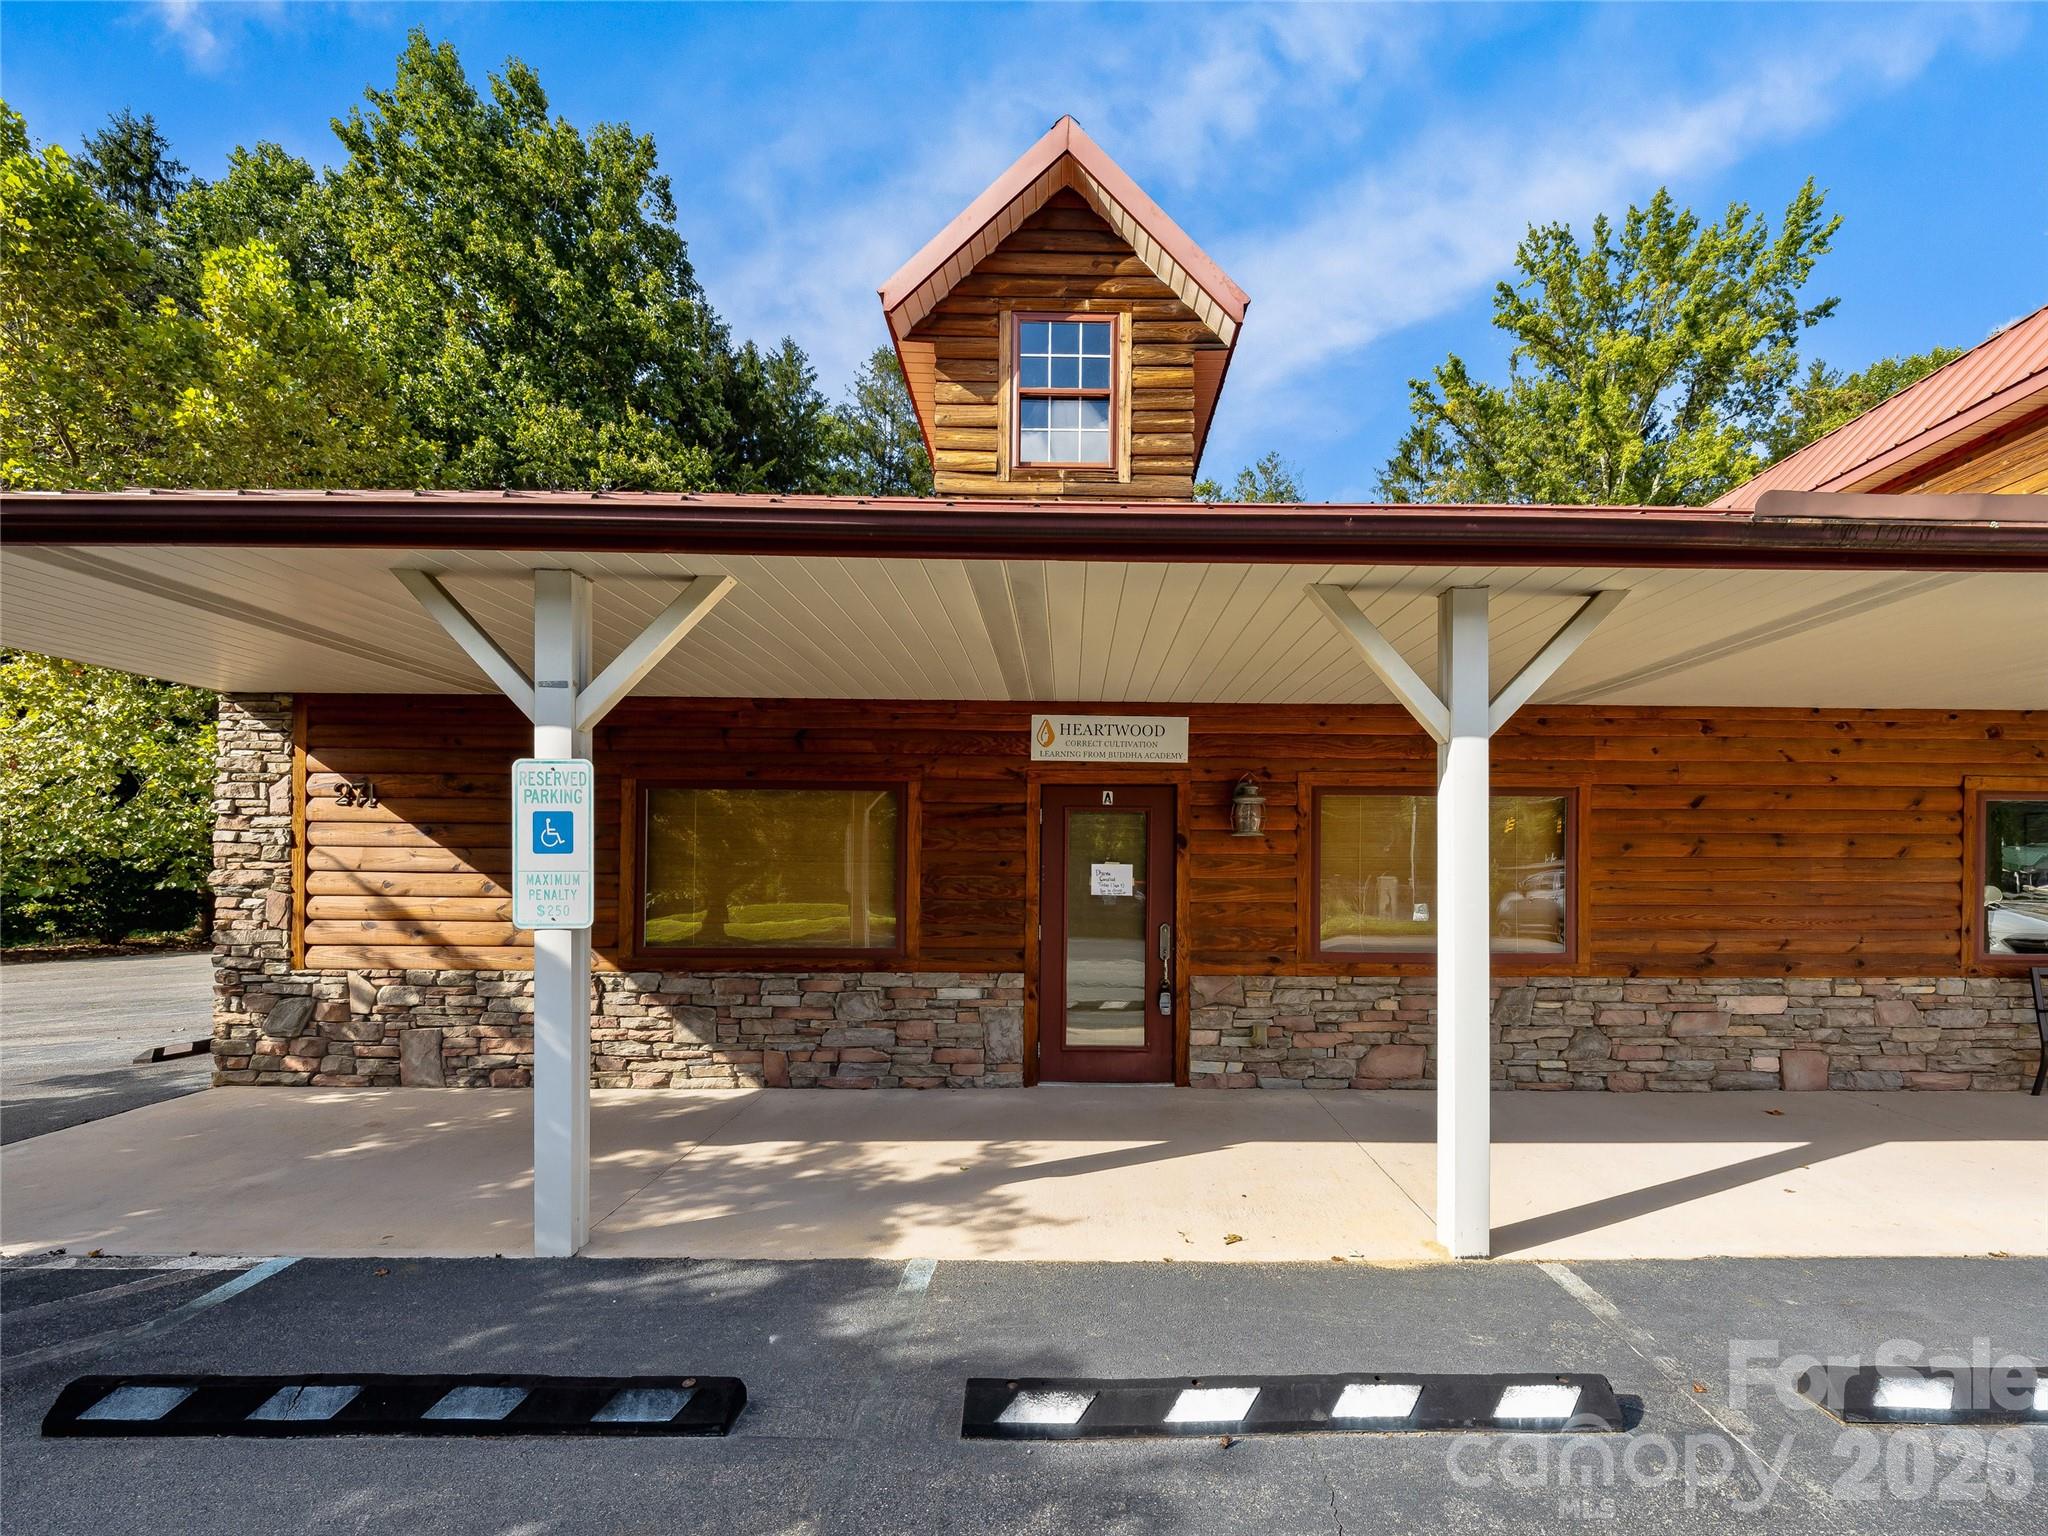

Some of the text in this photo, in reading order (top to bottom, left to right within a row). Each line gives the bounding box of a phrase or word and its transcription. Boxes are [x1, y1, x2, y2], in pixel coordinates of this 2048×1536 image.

[1060, 723, 1165, 737] HEARTWOOD
[1065, 740, 1158, 749] CORRECT CULTIVATION
[1040, 750, 1184, 760] LEARNING FROM BUDDHA ACADEMY
[519, 771, 587, 786] RESERVED
[524, 789, 583, 804] PARKING
[1104, 791, 1112, 804] A
[526, 873, 580, 886] MAXIMUM
[528, 889, 577, 901] PENALTY
[537, 904, 570, 917] $250
